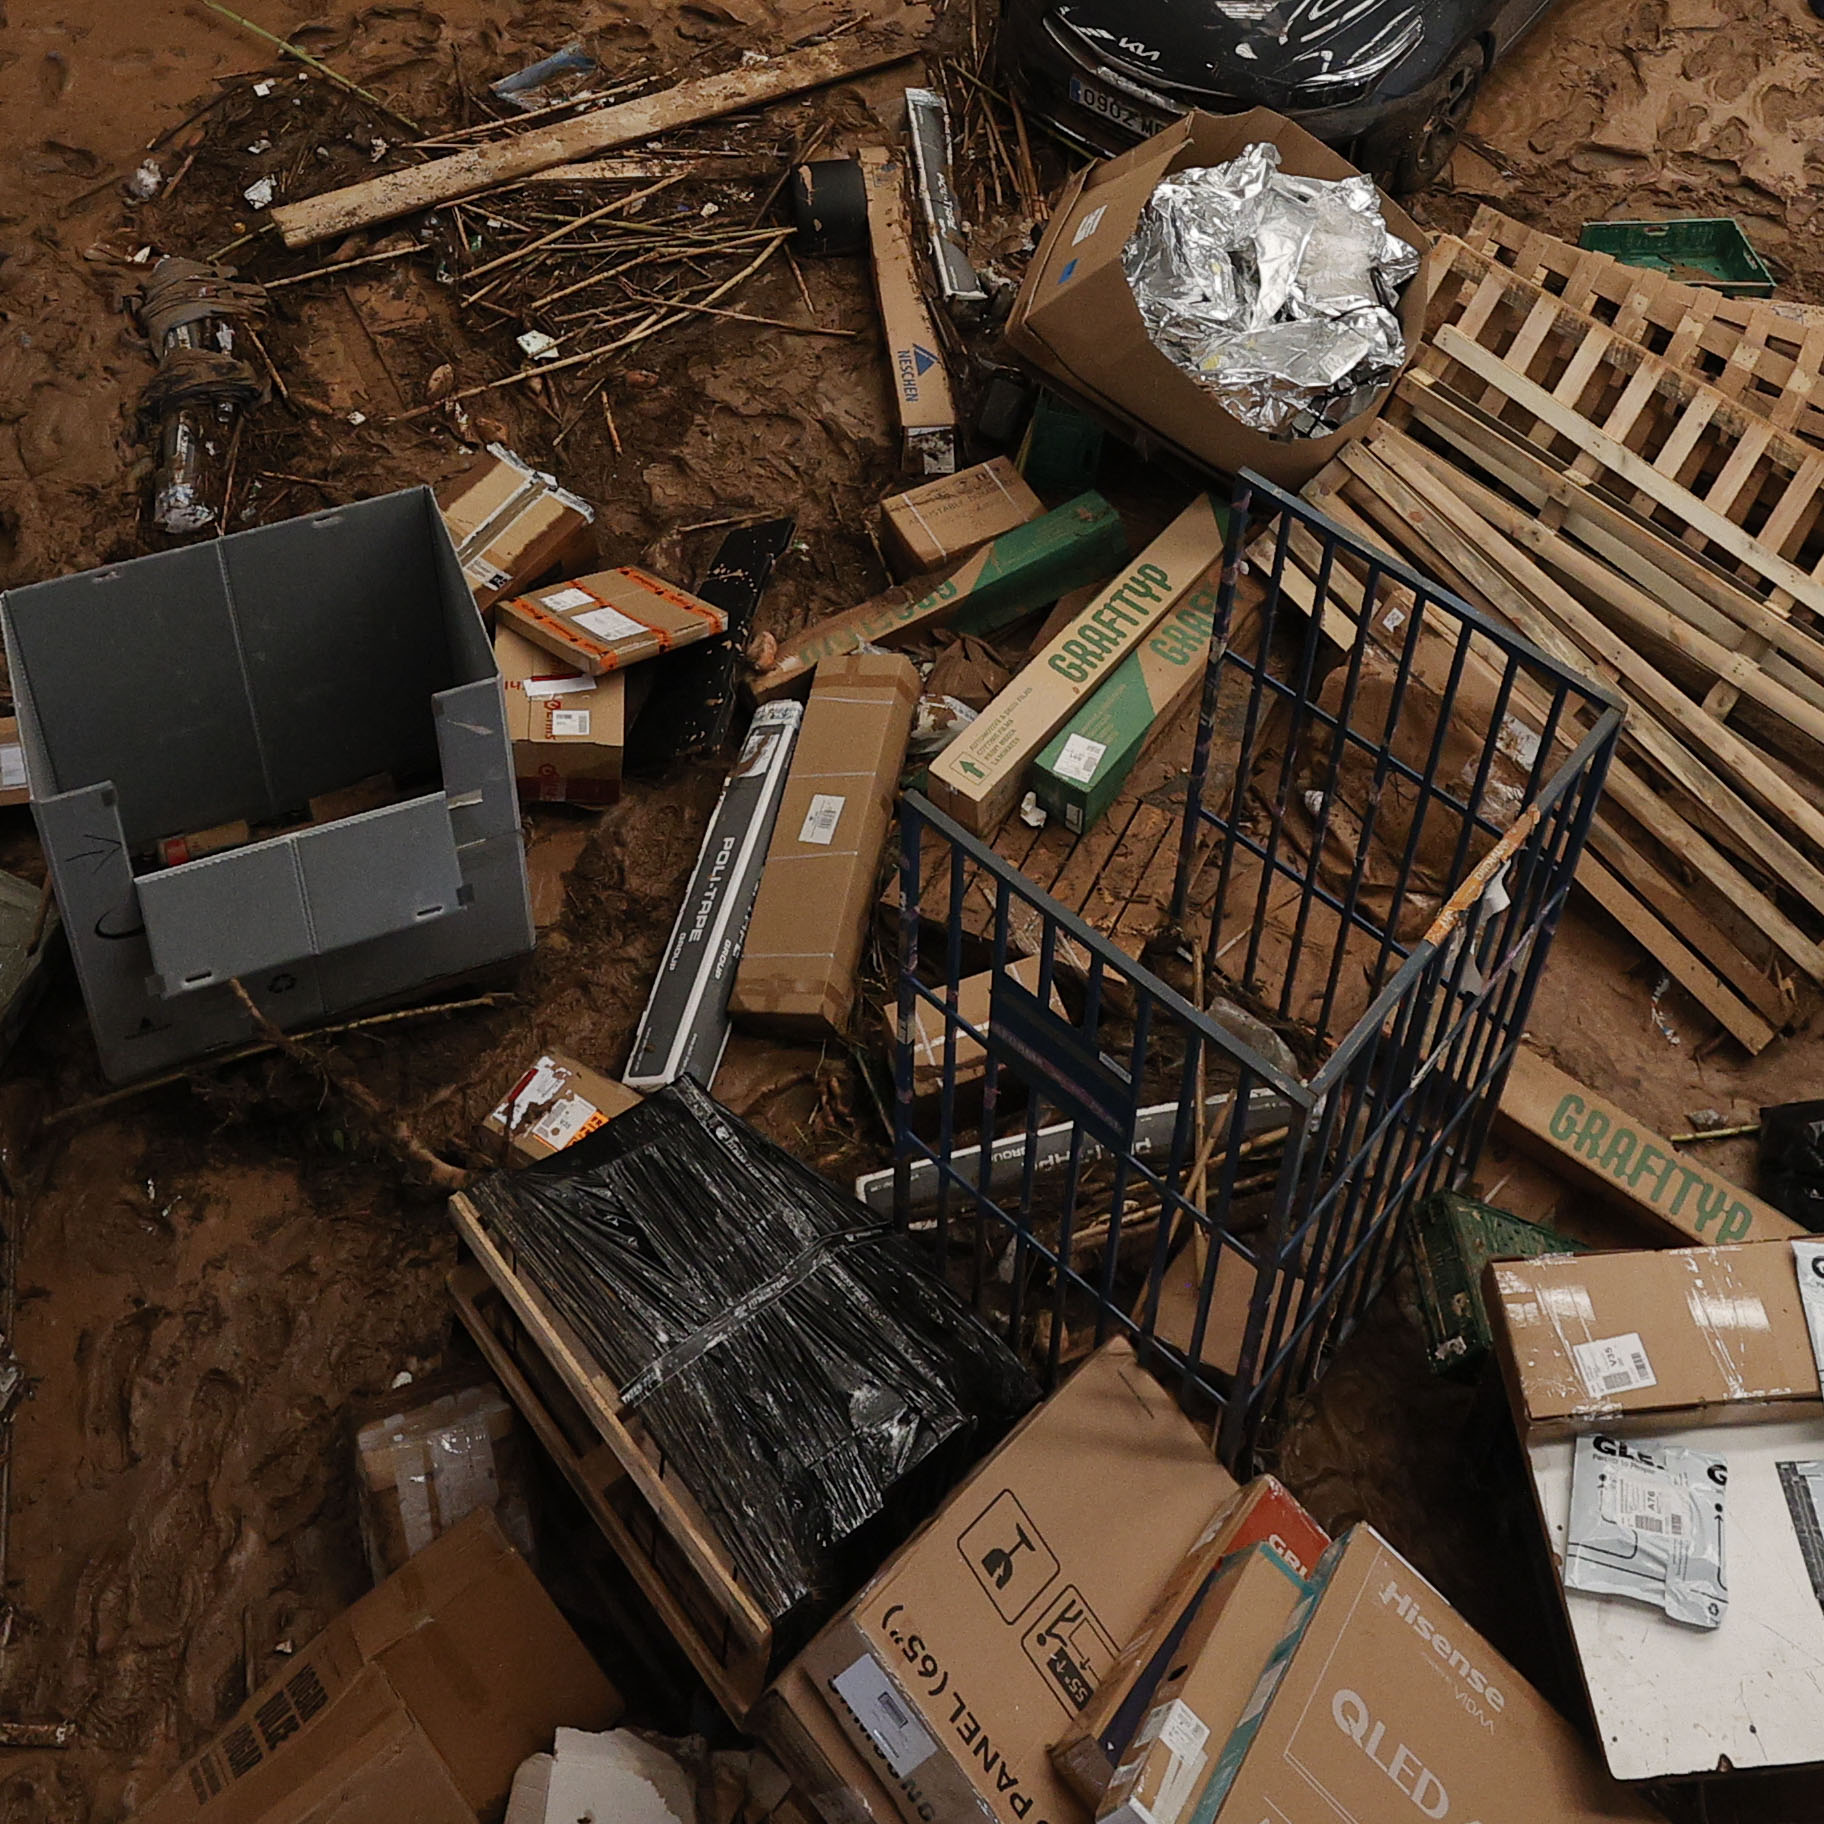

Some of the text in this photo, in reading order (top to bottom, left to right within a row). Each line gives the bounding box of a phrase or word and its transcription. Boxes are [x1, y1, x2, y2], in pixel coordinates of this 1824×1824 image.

[1083, 87, 1131, 125] 0902
[1117, 37, 1161, 61] KIA
[1048, 563, 1171, 684] GRAFITYP
[688, 835, 737, 944] POLI-TAPE
[666, 930, 688, 973] GROUP
[715, 937, 734, 980] GROUP
[1549, 1093, 1753, 1243] GRAFITYP
[1369, 1579, 1504, 1712] Hisense
[950, 1691, 1033, 1818] PANEL
[1332, 1688, 1450, 1820] QLED
